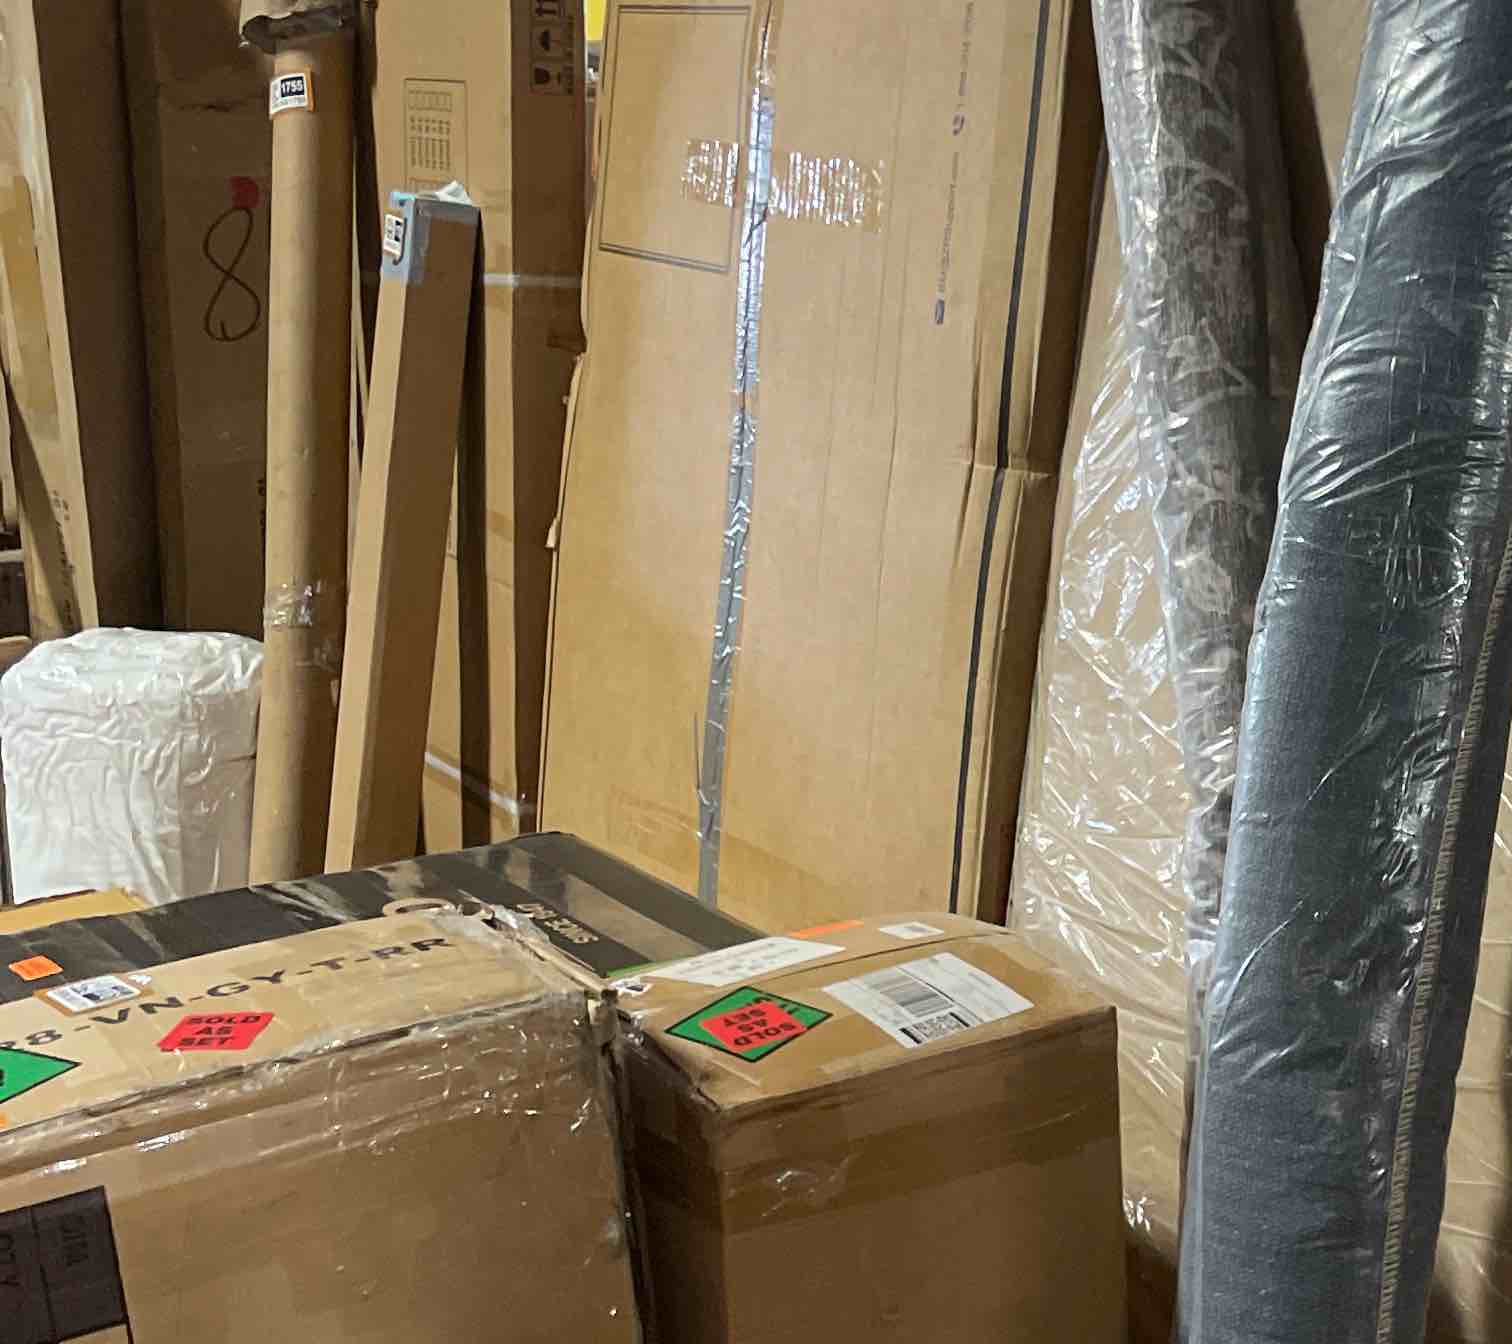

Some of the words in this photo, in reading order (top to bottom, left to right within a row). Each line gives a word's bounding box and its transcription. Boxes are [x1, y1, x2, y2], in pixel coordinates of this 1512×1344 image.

[187, 1014, 264, 1025] SOLD
[193, 1025, 234, 1036] AS
[733, 1023, 797, 1046] SOLD
[178, 1036, 238, 1046] SET
